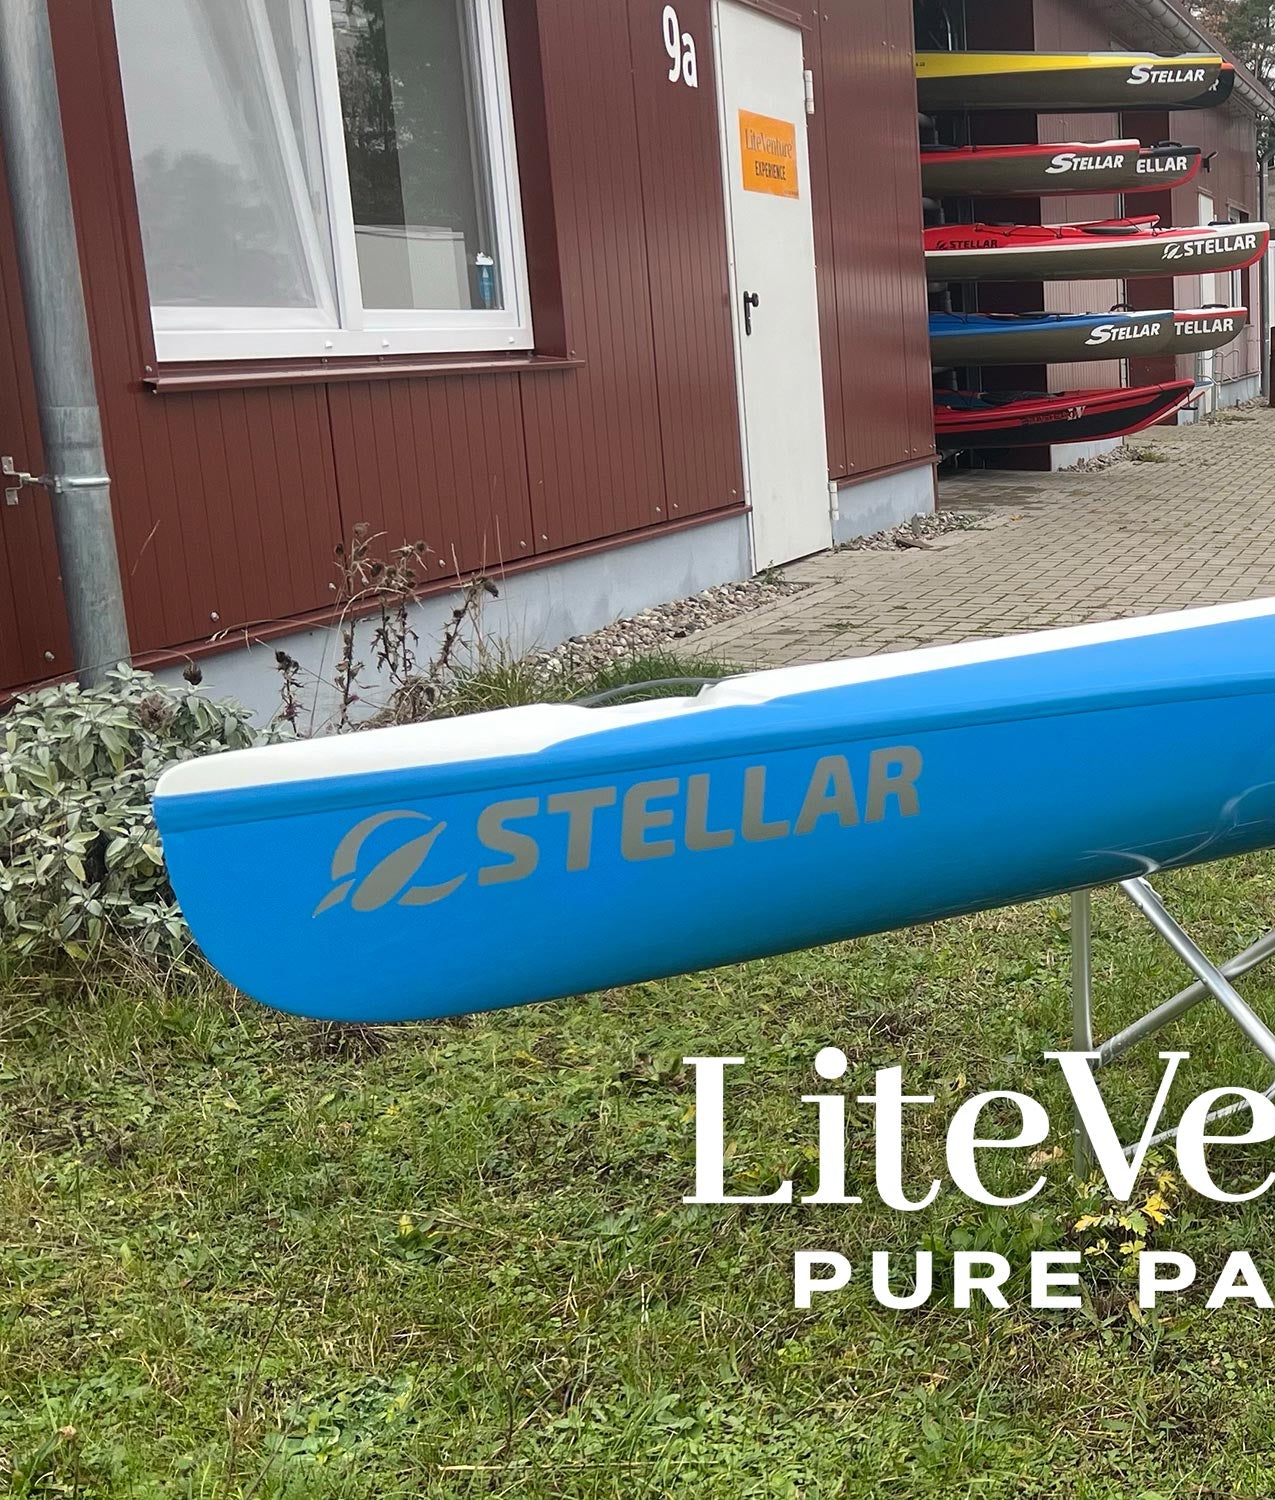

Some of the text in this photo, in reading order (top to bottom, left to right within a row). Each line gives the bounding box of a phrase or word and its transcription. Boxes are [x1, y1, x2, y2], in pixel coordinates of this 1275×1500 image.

[662, 5, 698, 88] 9a
[1126, 64, 1205, 85] STELLAR
[755, 160, 786, 181] EXPERIENCE
[1045, 153, 1124, 174] STELLAR
[1136, 156, 1187, 173] ELLAR
[949, 240, 998, 251] STELLAR
[1183, 233, 1257, 257] STELLAR
[1084, 322, 1161, 345] STELLAR
[1174, 318, 1234, 335] TELLAR
[476, 745, 923, 887] STELLAR
